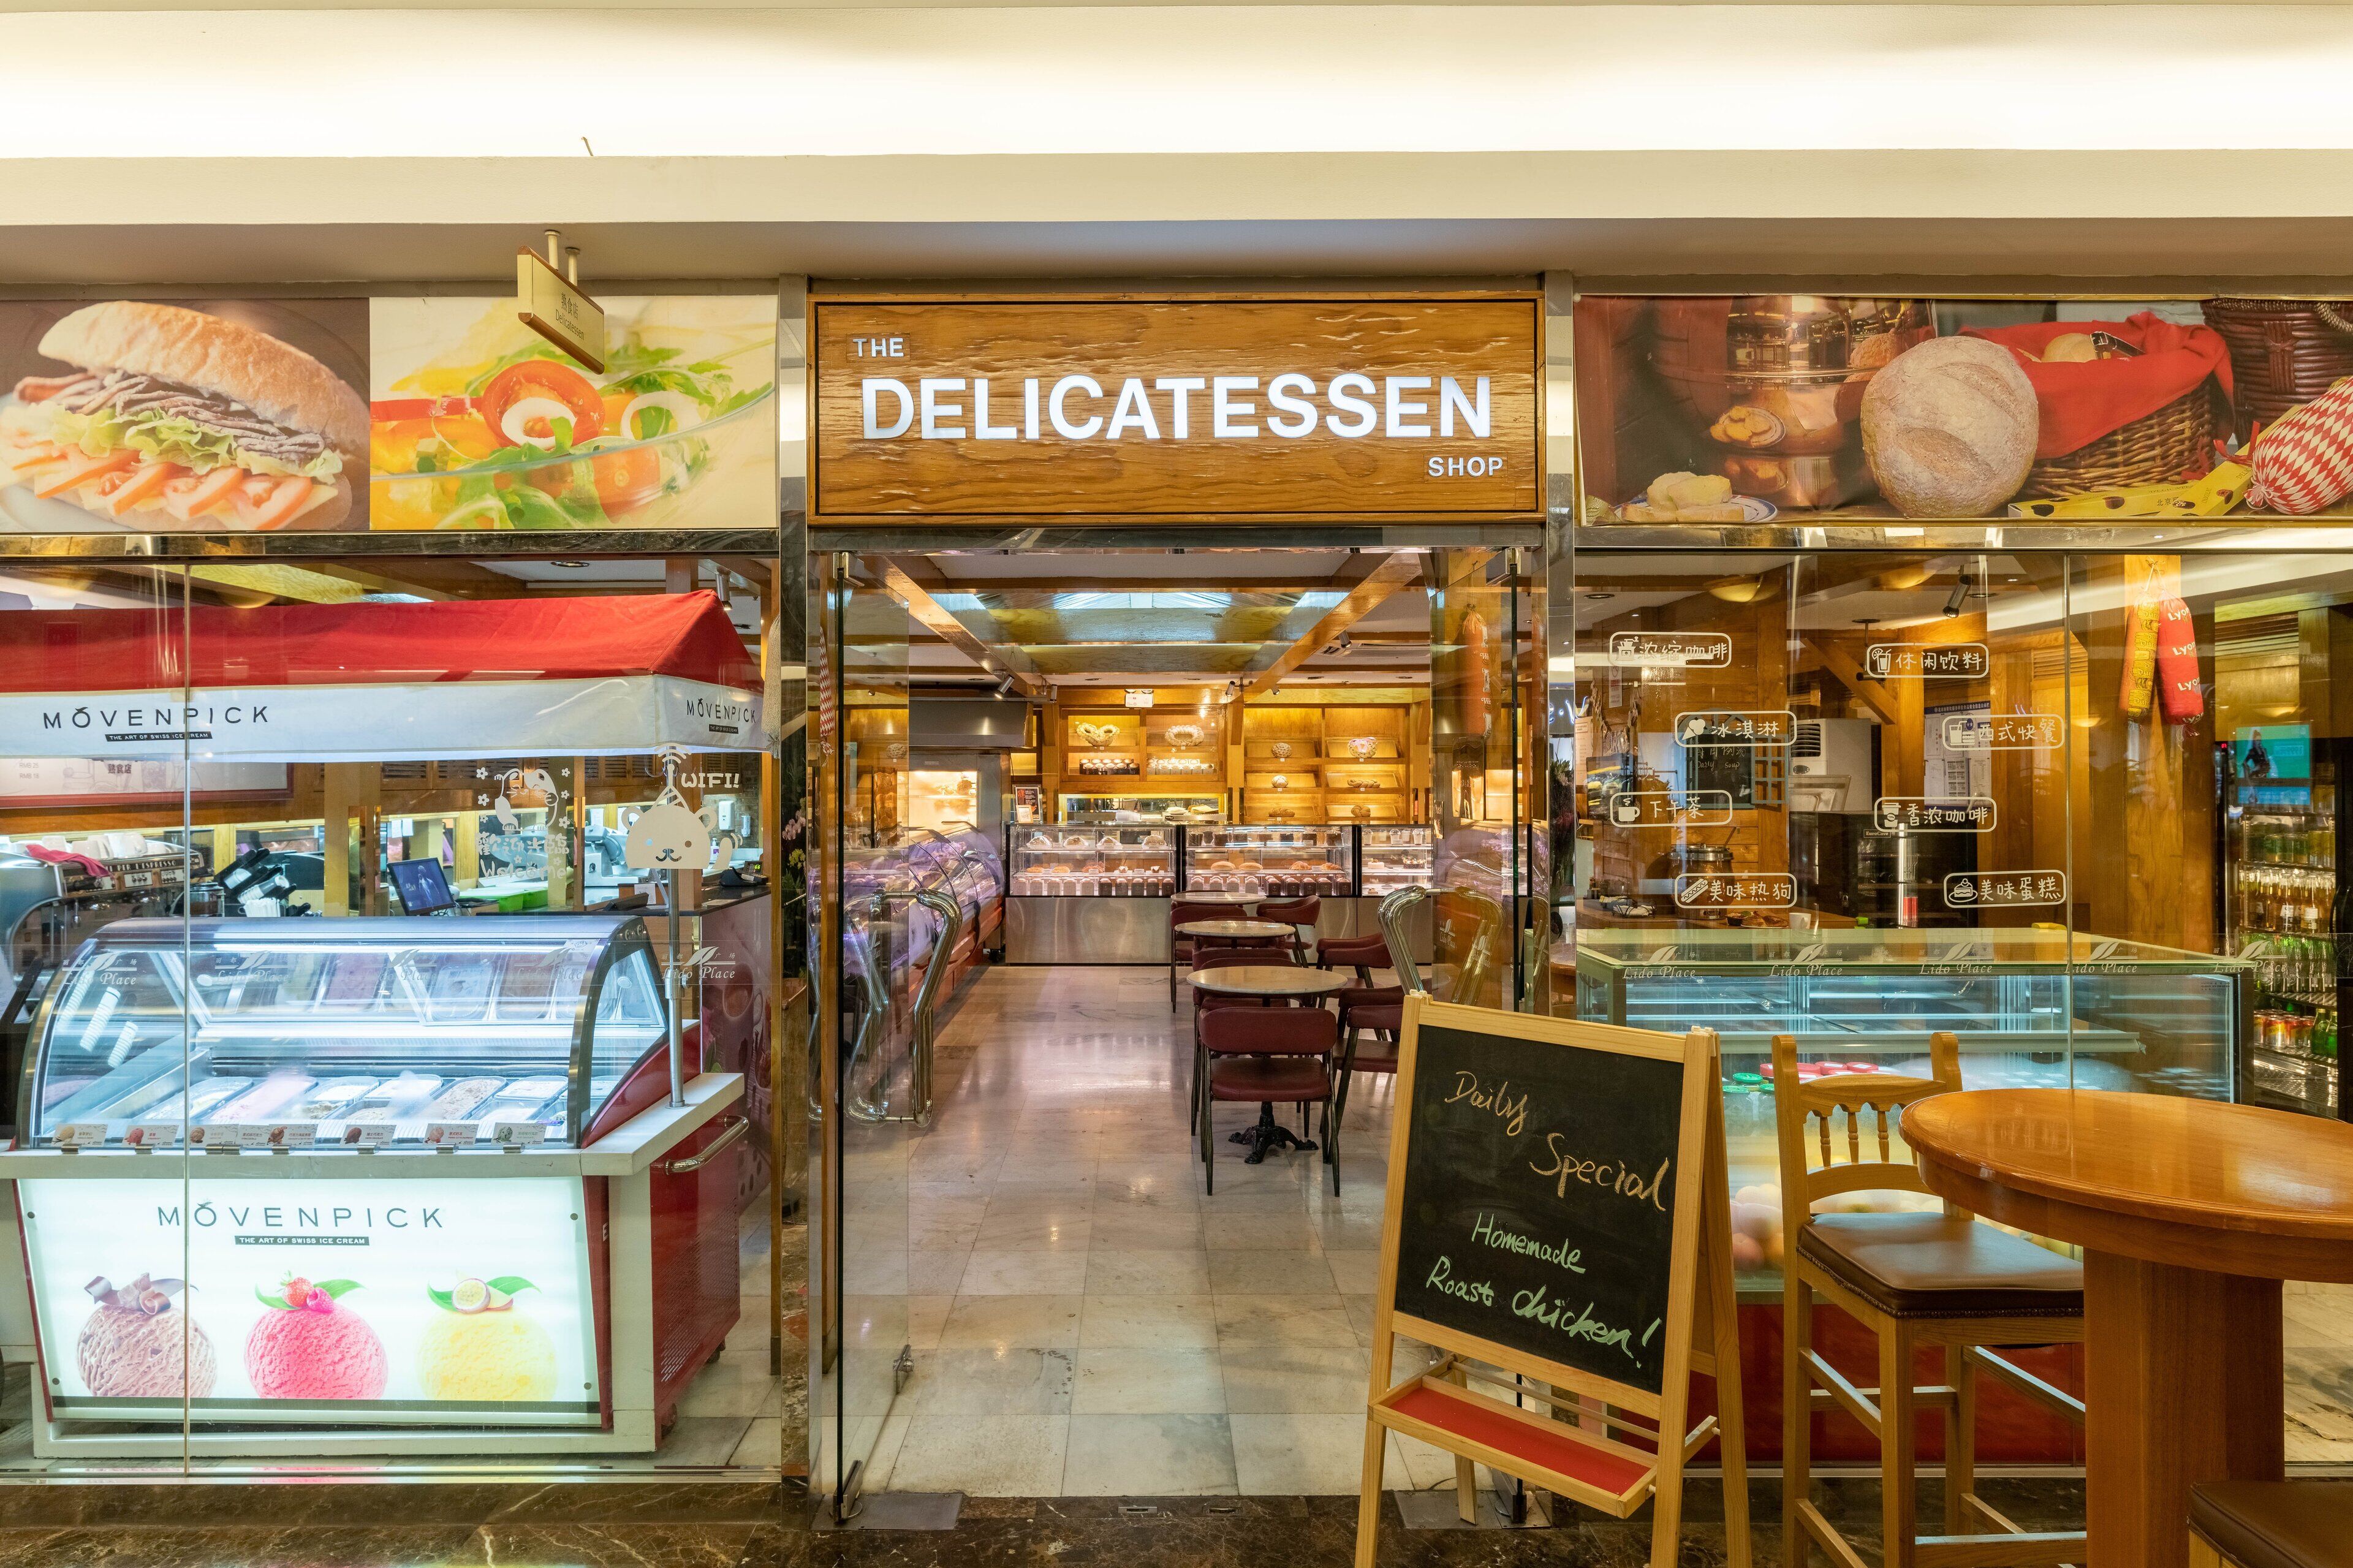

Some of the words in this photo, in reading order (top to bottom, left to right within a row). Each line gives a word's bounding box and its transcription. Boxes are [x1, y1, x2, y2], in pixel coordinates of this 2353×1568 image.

[561, 292, 578, 320] 熟食店
[555, 308, 585, 341] Delicatessen
[852, 337, 904, 358] THE
[861, 373, 1491, 441] DELICATESSEN
[1427, 455, 1504, 478] SHOP
[1639, 641, 1729, 661] 浓缩咖啡
[1896, 652, 1983, 672] 休闲饮料
[1710, 721, 1780, 740] 冰淇淋
[1978, 718, 2059, 744] 西式快餐
[681, 773, 740, 789] WIFI!
[1648, 798, 1705, 819] 下午茶
[1906, 803, 1989, 827] 香浓咖啡
[479, 858, 567, 881] Welcome
[1709, 880, 1792, 903] 美味热狗
[1979, 877, 2062, 901] 美味蛋糕
[700, 966, 735, 979] Place
[1622, 967, 1653, 979] Lido
[1659, 966, 1696, 979] Place
[1770, 964, 1800, 977] Lido
[1806, 964, 1843, 977] Place
[1919, 963, 1950, 975] Lido
[1956, 962, 1993, 974] Place
[2064, 961, 2096, 974] Lido
[2101, 960, 2138, 974] Place
[2213, 960, 2245, 973] Lido
[2251, 960, 2287, 974] Place
[100, 972, 137, 985] Place
[1444, 1070, 1528, 1137] Daily
[1529, 1132, 1670, 1212] Special
[1471, 1211, 1586, 1274] Homemade
[1425, 1256, 1495, 1308] Roast
